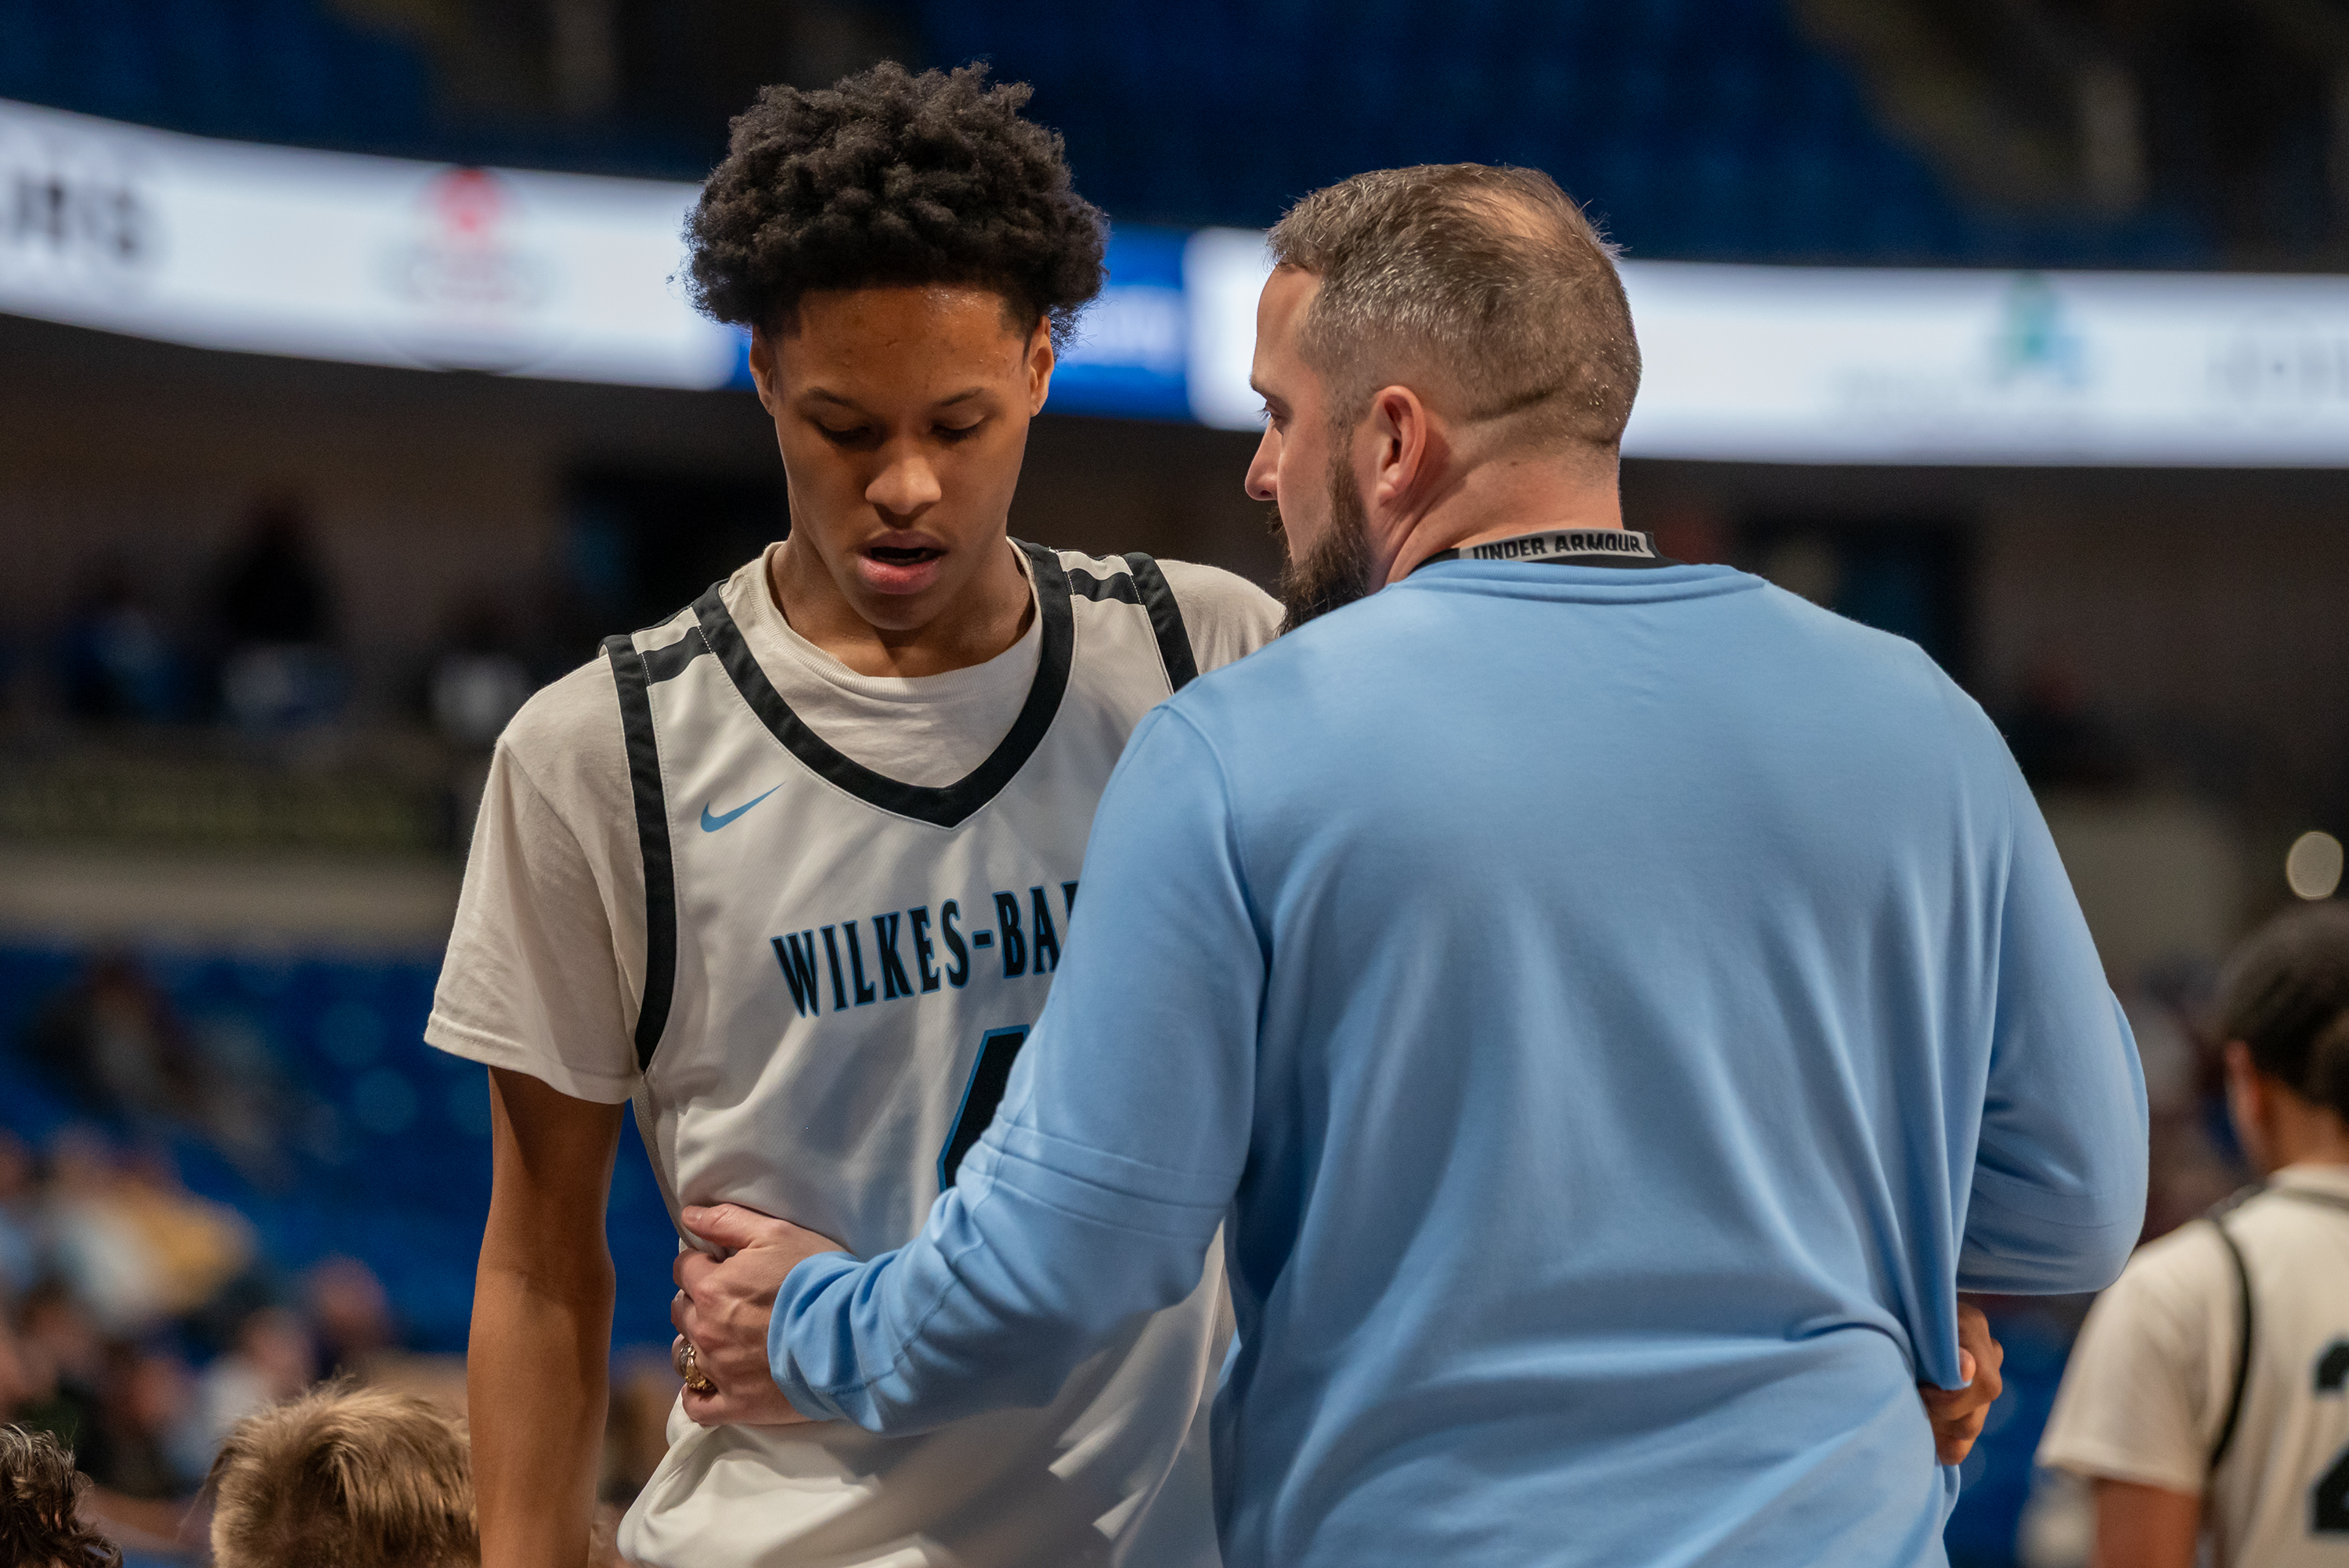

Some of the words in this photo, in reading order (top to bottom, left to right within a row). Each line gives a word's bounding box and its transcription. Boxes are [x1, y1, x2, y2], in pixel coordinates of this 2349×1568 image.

[1472, 537, 1547, 561] UNDER
[1555, 533, 1644, 553] ARMOUR
[770, 880, 1079, 1018] WILKES-BA
